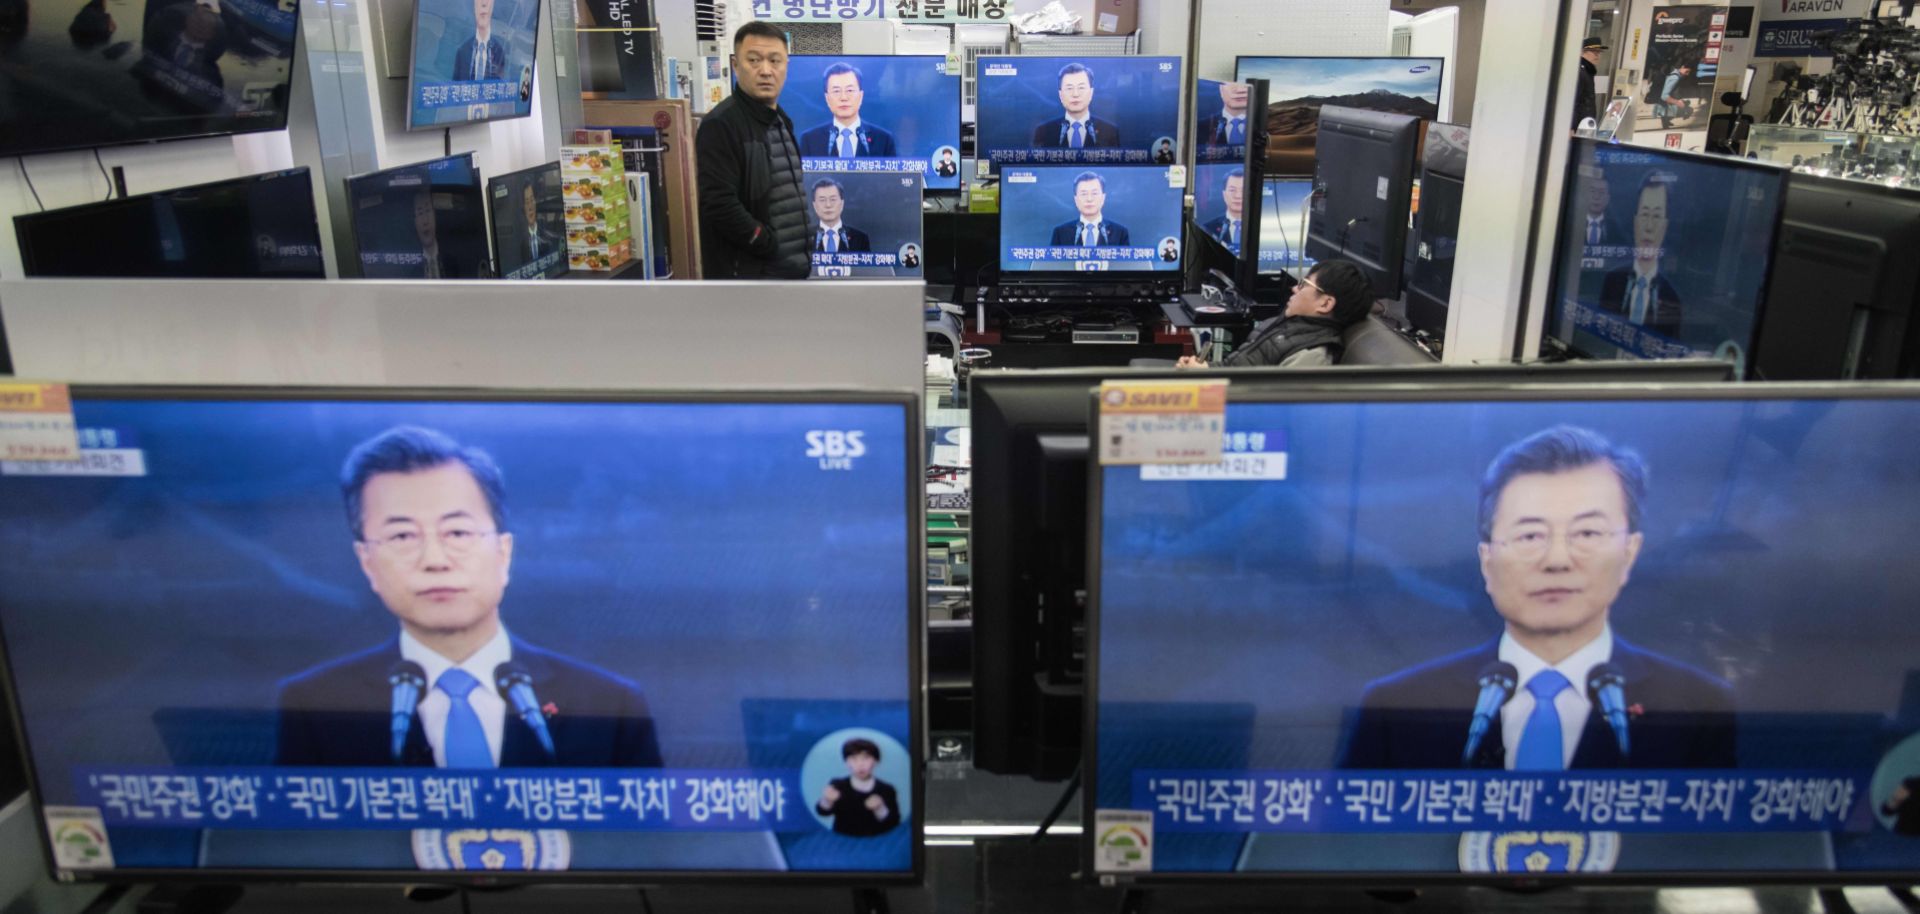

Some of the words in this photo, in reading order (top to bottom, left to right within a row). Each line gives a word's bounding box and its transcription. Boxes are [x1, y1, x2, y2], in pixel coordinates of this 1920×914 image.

[896, 0, 945, 19] 전문
[956, 0, 1006, 19] 매장
[621, 13, 633, 36] LED
[624, 39, 635, 55] TV
[1130, 391, 1193, 407] SAVE!
[805, 429, 866, 458] SBS
[818, 458, 852, 471] LIVE
[89, 774, 199, 820] '국민주권
[342, 776, 418, 821] 기본권
[685, 777, 785, 822] 강화해야
[1149, 778, 1255, 823] '국민주권
[1400, 778, 1476, 823] 기본권
[1749, 778, 1855, 824] 강화해야
